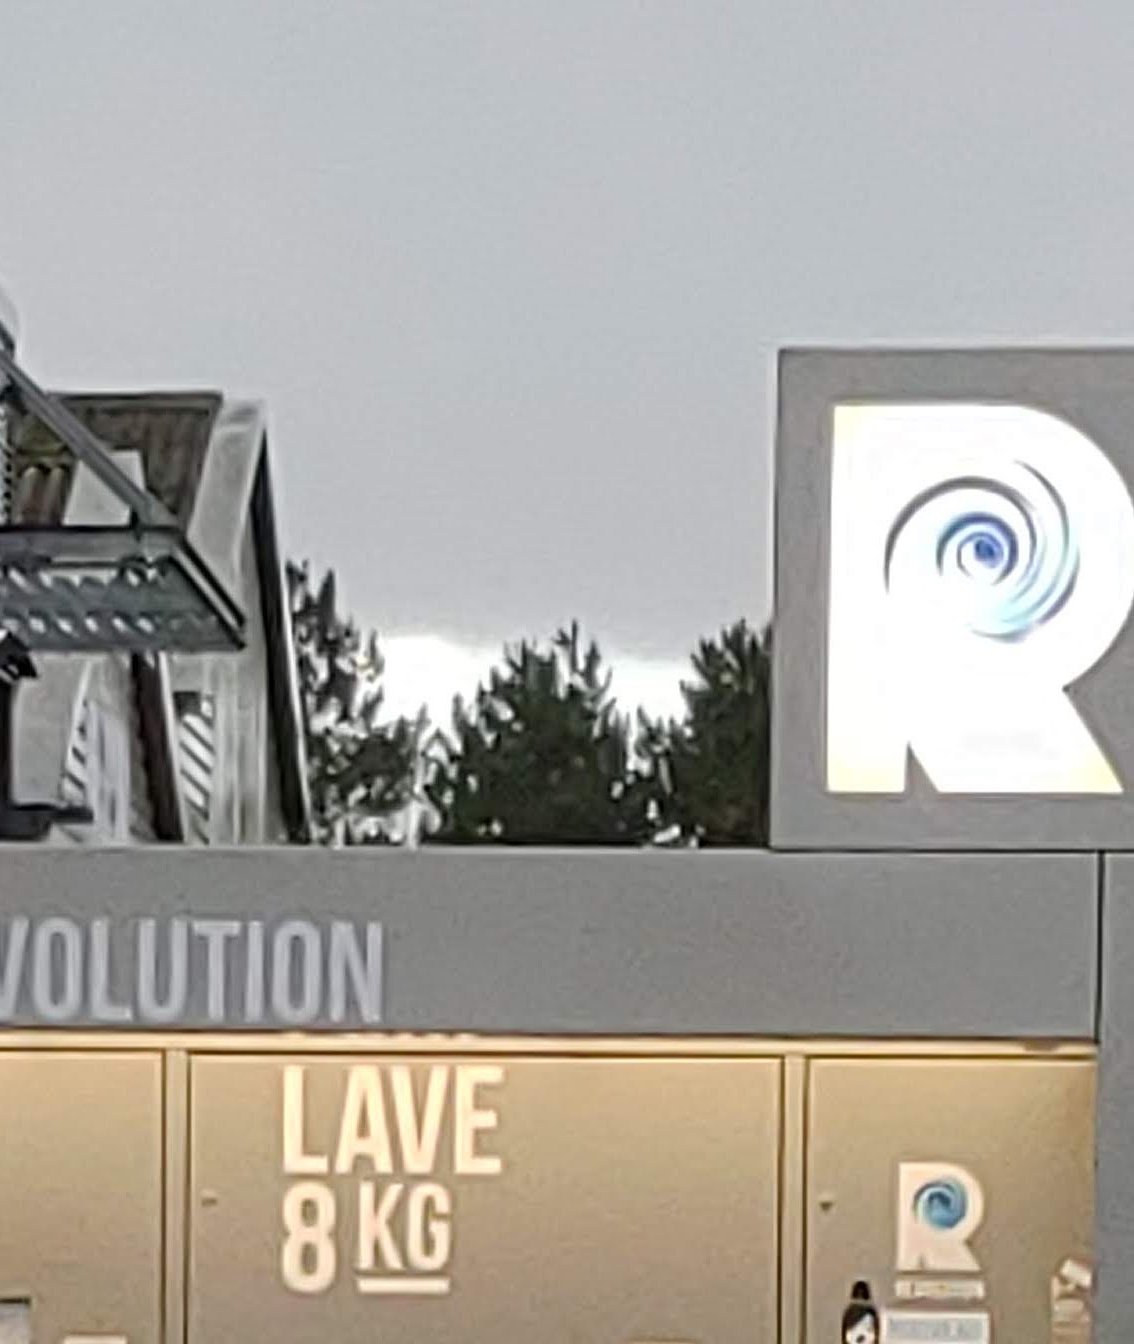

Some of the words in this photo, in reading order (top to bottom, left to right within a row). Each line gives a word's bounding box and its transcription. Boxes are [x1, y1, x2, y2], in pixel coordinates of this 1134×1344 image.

[826, 403, 1134, 794] R
[281, 1065, 506, 1176] LAVE
[281, 1181, 337, 1296] 8
[357, 1181, 453, 1272] KG
